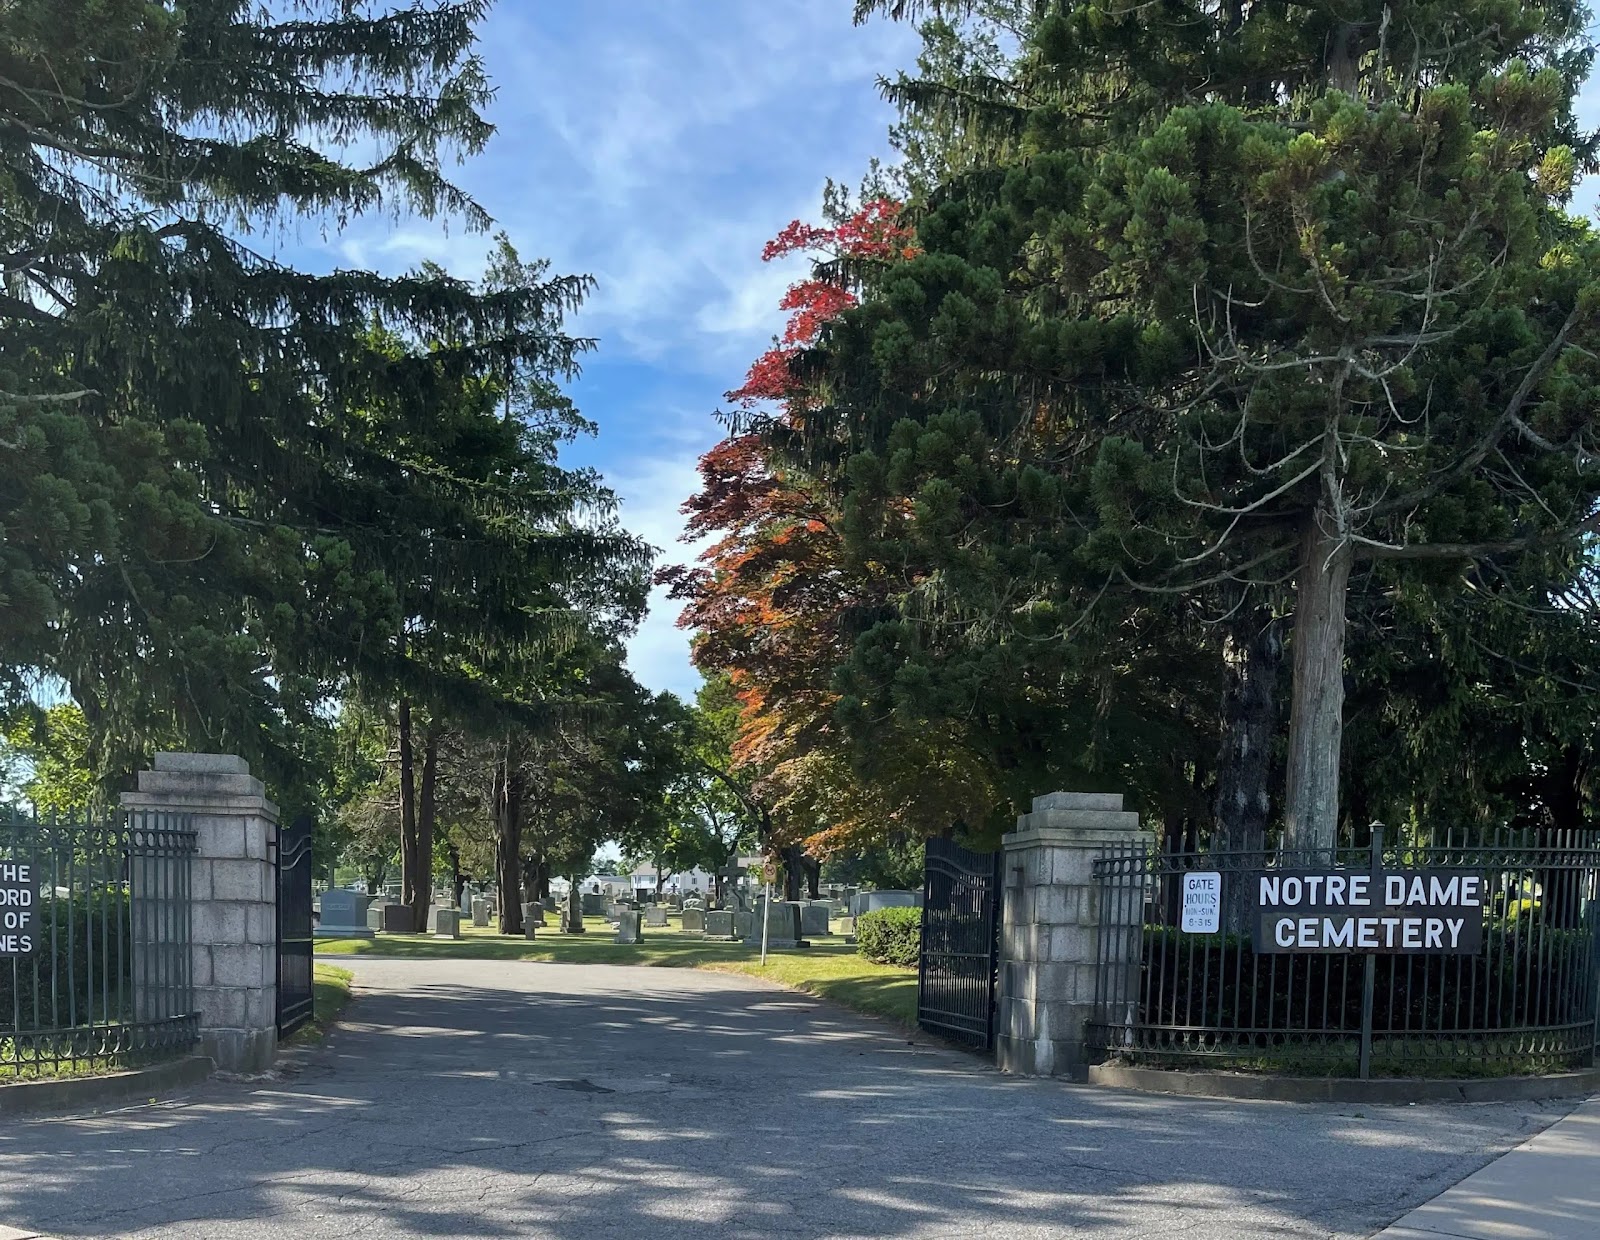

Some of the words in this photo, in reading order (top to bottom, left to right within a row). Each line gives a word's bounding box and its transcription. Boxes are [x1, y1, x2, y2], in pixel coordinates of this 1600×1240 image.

[0, 864, 30, 882] HE
[1189, 879, 1214, 890] GATE
[1259, 876, 1371, 906] NOTRE
[1385, 876, 1480, 906] DAME
[1186, 893, 1216, 905] HOURS
[4, 912, 31, 928] OF
[1275, 917, 1464, 948] CEMETERY
